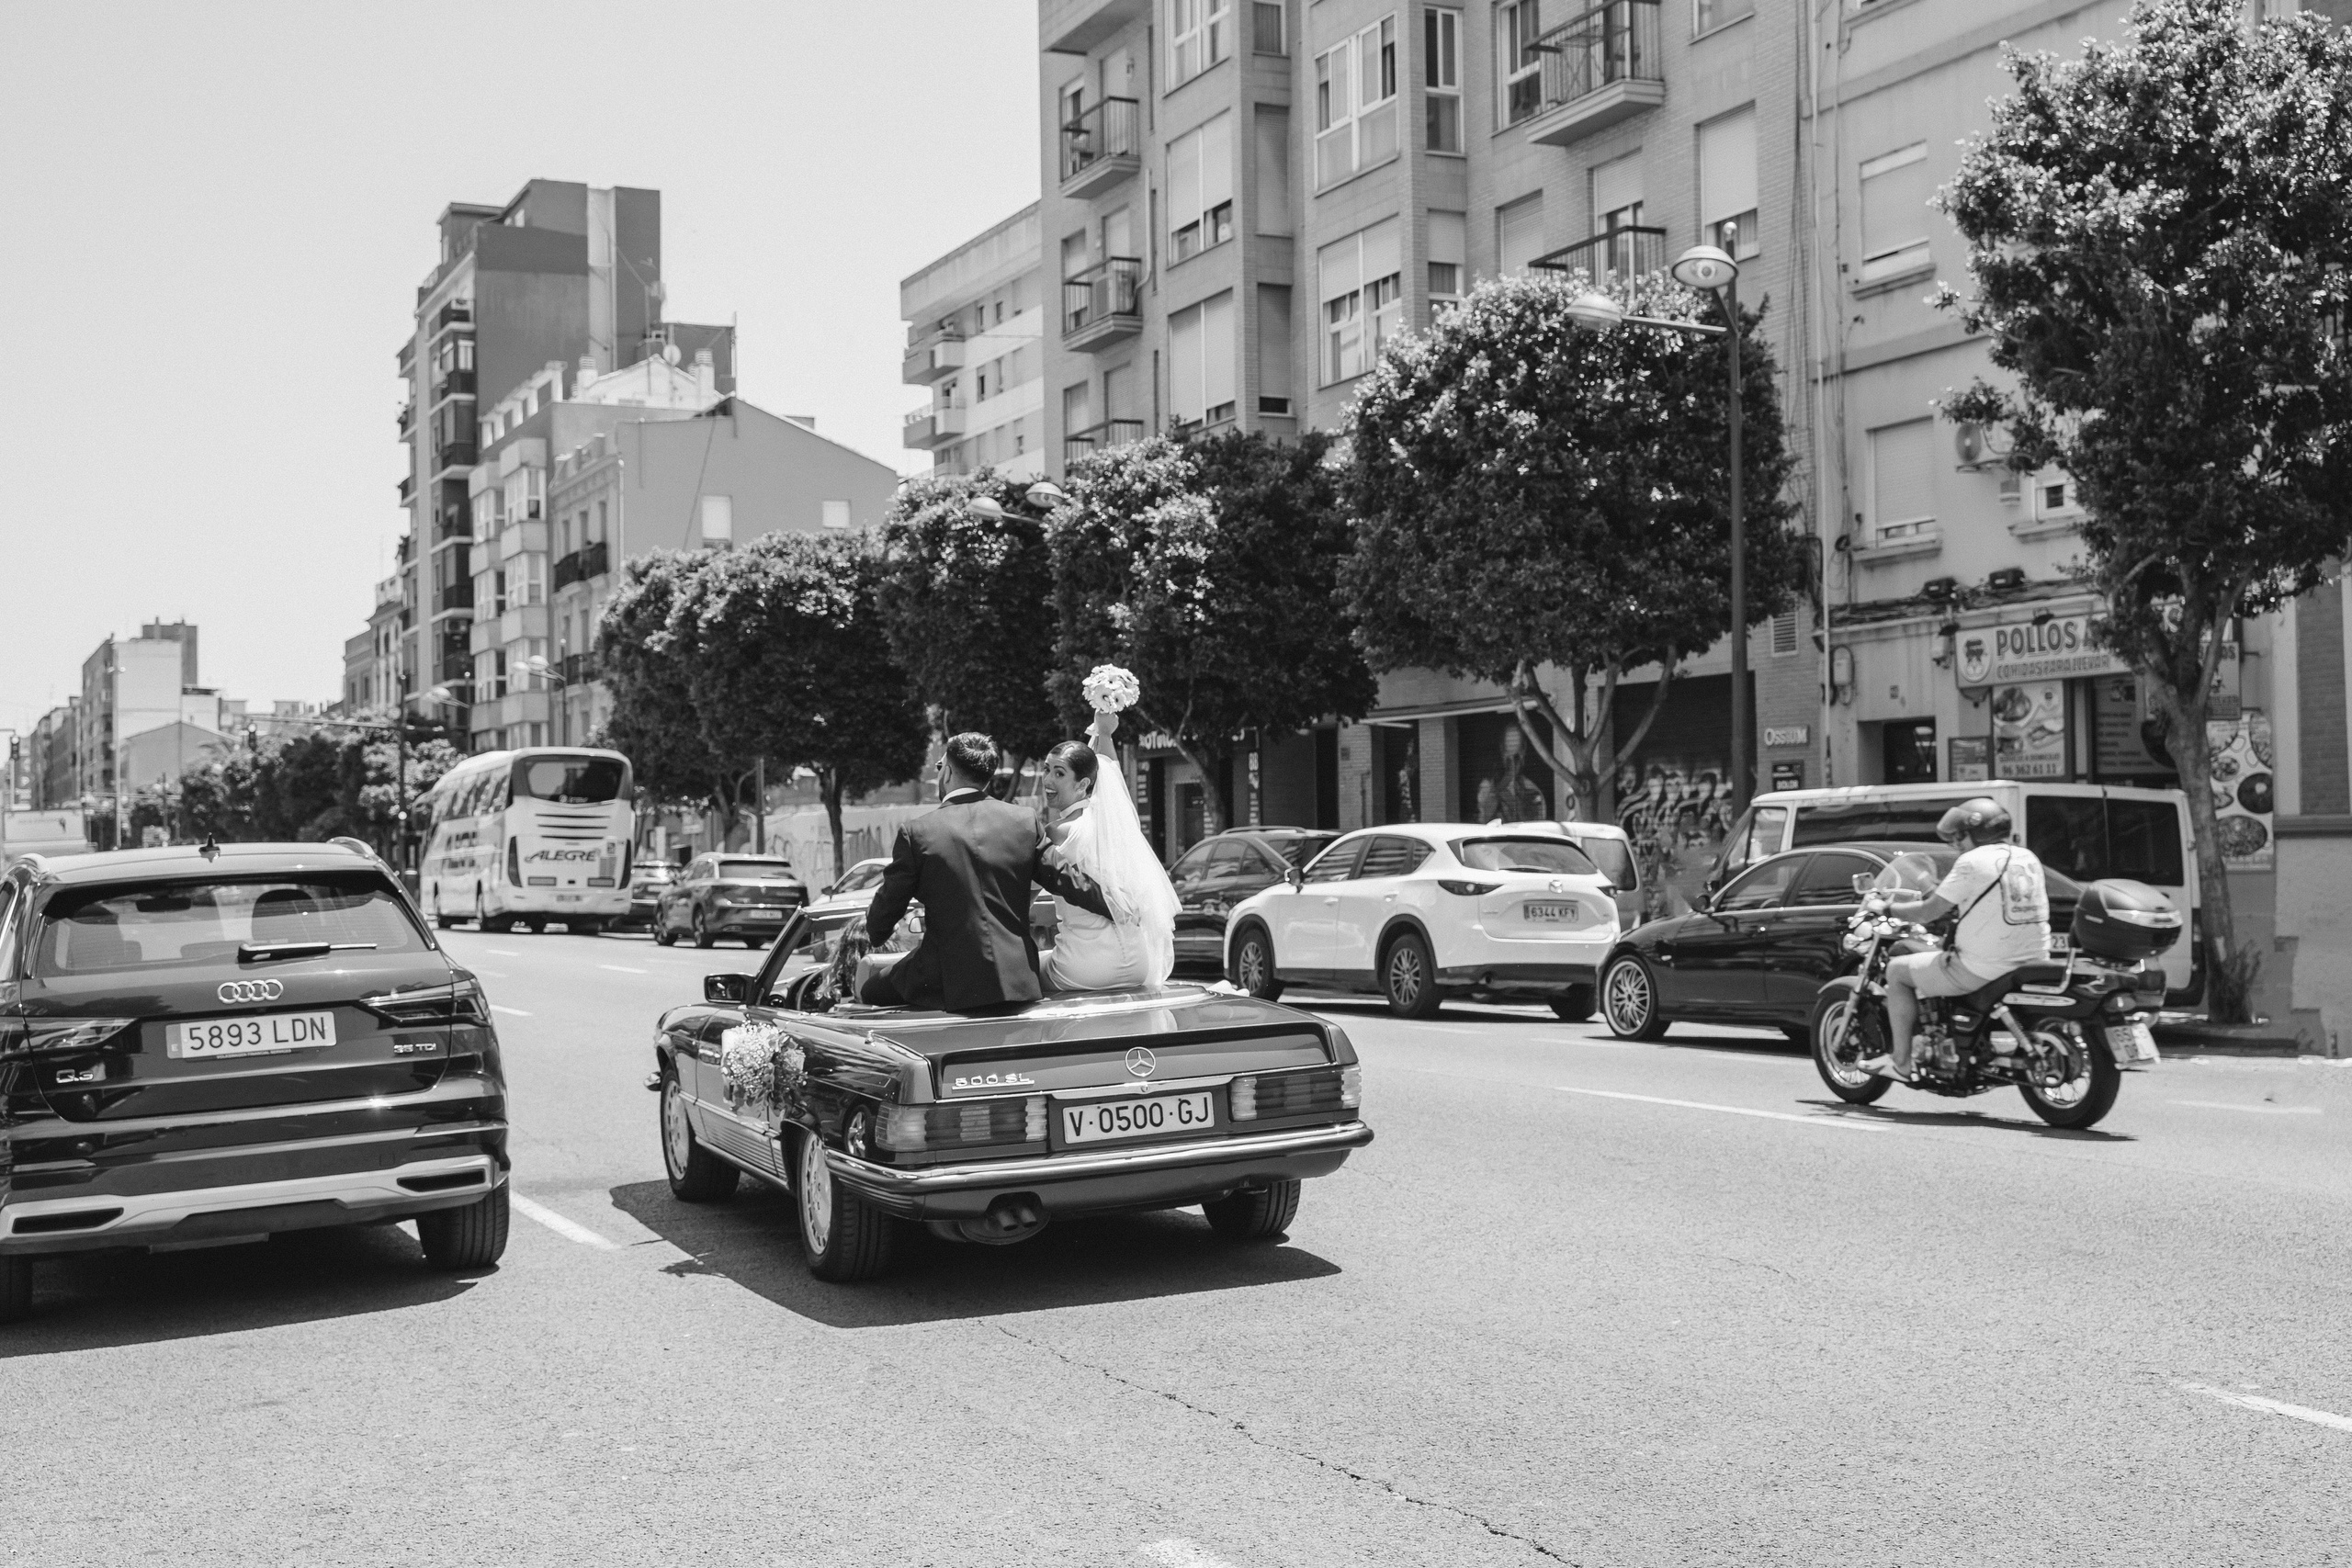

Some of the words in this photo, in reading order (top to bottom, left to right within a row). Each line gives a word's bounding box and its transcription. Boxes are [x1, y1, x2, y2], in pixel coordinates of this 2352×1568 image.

[1996, 621, 2077, 658] POLLOS
[525, 849, 597, 863] ALEGRE
[1531, 907, 1555, 918] 6344
[188, 1021, 262, 1051] 5893
[273, 1016, 326, 1043] LDN
[414, 1042, 436, 1052] TDI
[955, 1073, 999, 1087] 500
[1005, 1072, 1030, 1083] SL
